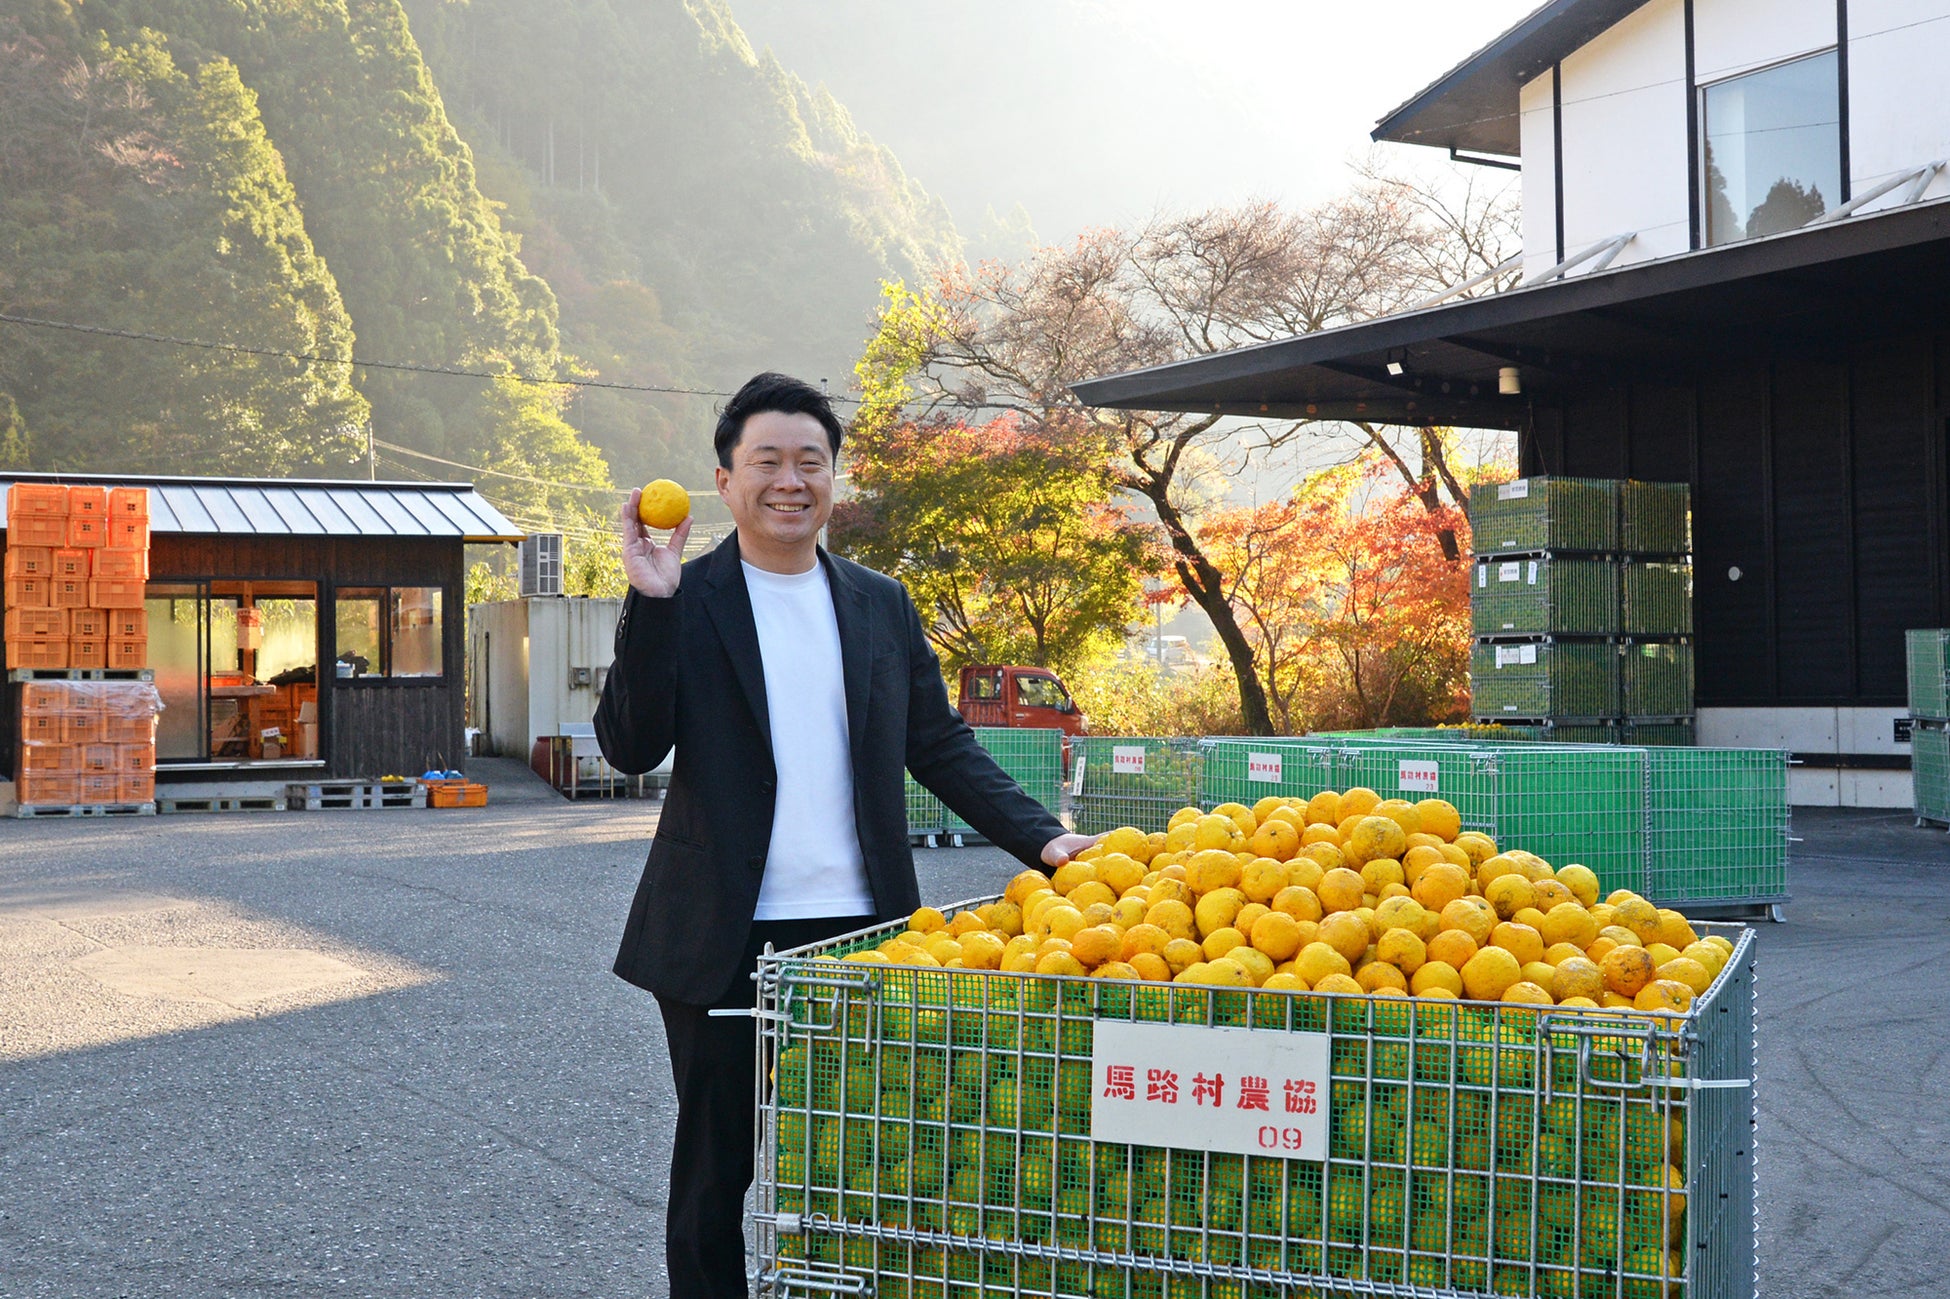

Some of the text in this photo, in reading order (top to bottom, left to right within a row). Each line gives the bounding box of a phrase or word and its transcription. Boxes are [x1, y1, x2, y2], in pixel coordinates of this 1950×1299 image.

[1103, 1065, 1317, 1115] 馬路村農協
[1258, 1125, 1302, 1150] 09
